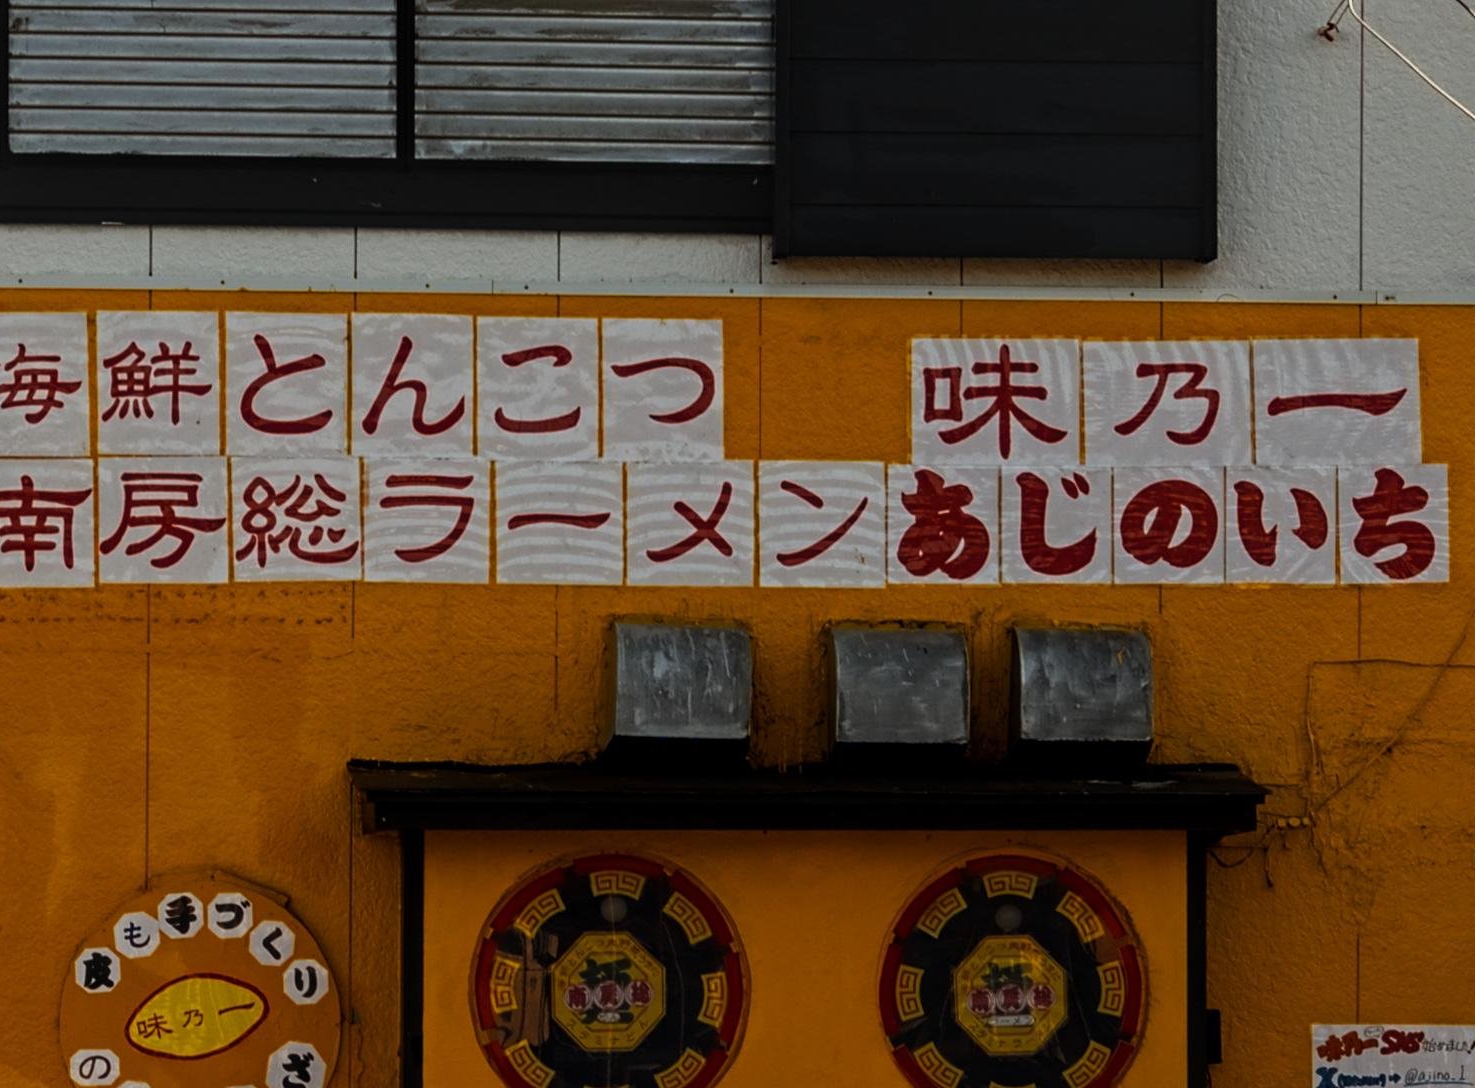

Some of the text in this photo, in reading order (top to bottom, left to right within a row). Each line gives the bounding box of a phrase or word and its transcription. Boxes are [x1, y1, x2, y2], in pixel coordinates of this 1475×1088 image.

[923, 344, 1407, 460] 味乃一
[895, 466, 1436, 580] あじのいち
[136, 1001, 256, 1040] 味乃一
